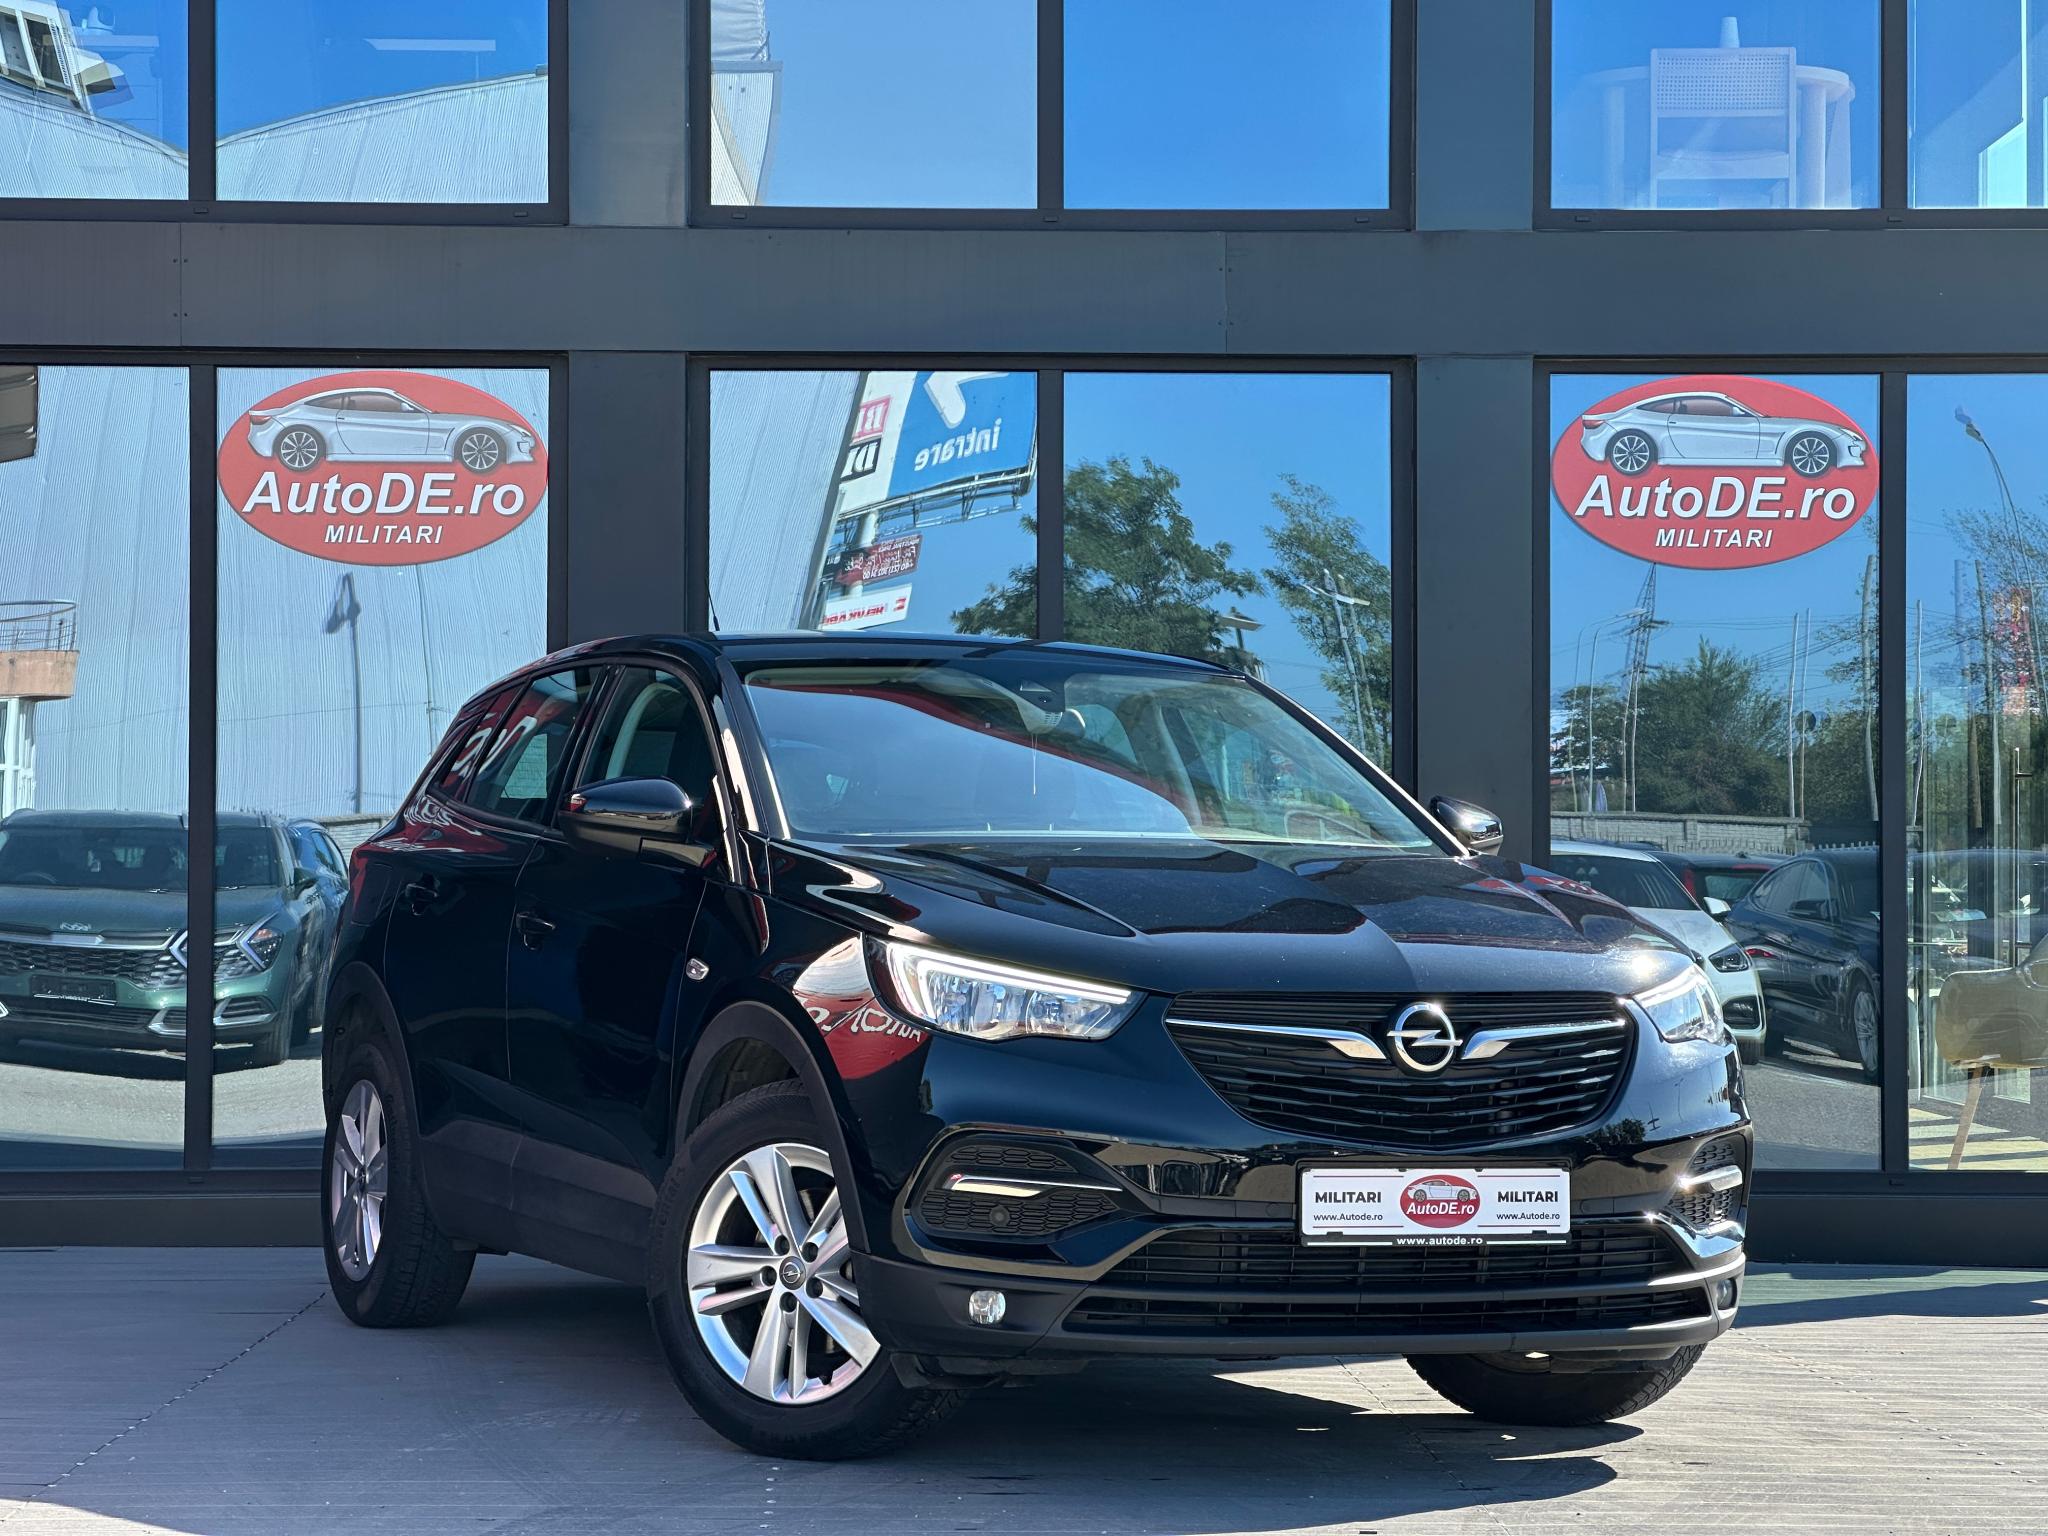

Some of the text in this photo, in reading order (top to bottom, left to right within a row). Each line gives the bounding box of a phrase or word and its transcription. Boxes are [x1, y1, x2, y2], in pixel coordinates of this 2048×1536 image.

[241, 471, 525, 515] AutoDE.ro
[1574, 474, 1856, 520] AutoDE.ro
[324, 524, 443, 544] MILITARI
[1655, 528, 1774, 548] MILITARI
[1315, 1191, 1382, 1203] MILITARI
[1497, 1190, 1558, 1203] MILITARI
[1406, 1202, 1475, 1215] AutoDE.ro
[1313, 1213, 1383, 1221] www.Autode.ro
[1496, 1212, 1560, 1220] www.Autode.ro
[1396, 1236, 1483, 1245] www.autode.ro
